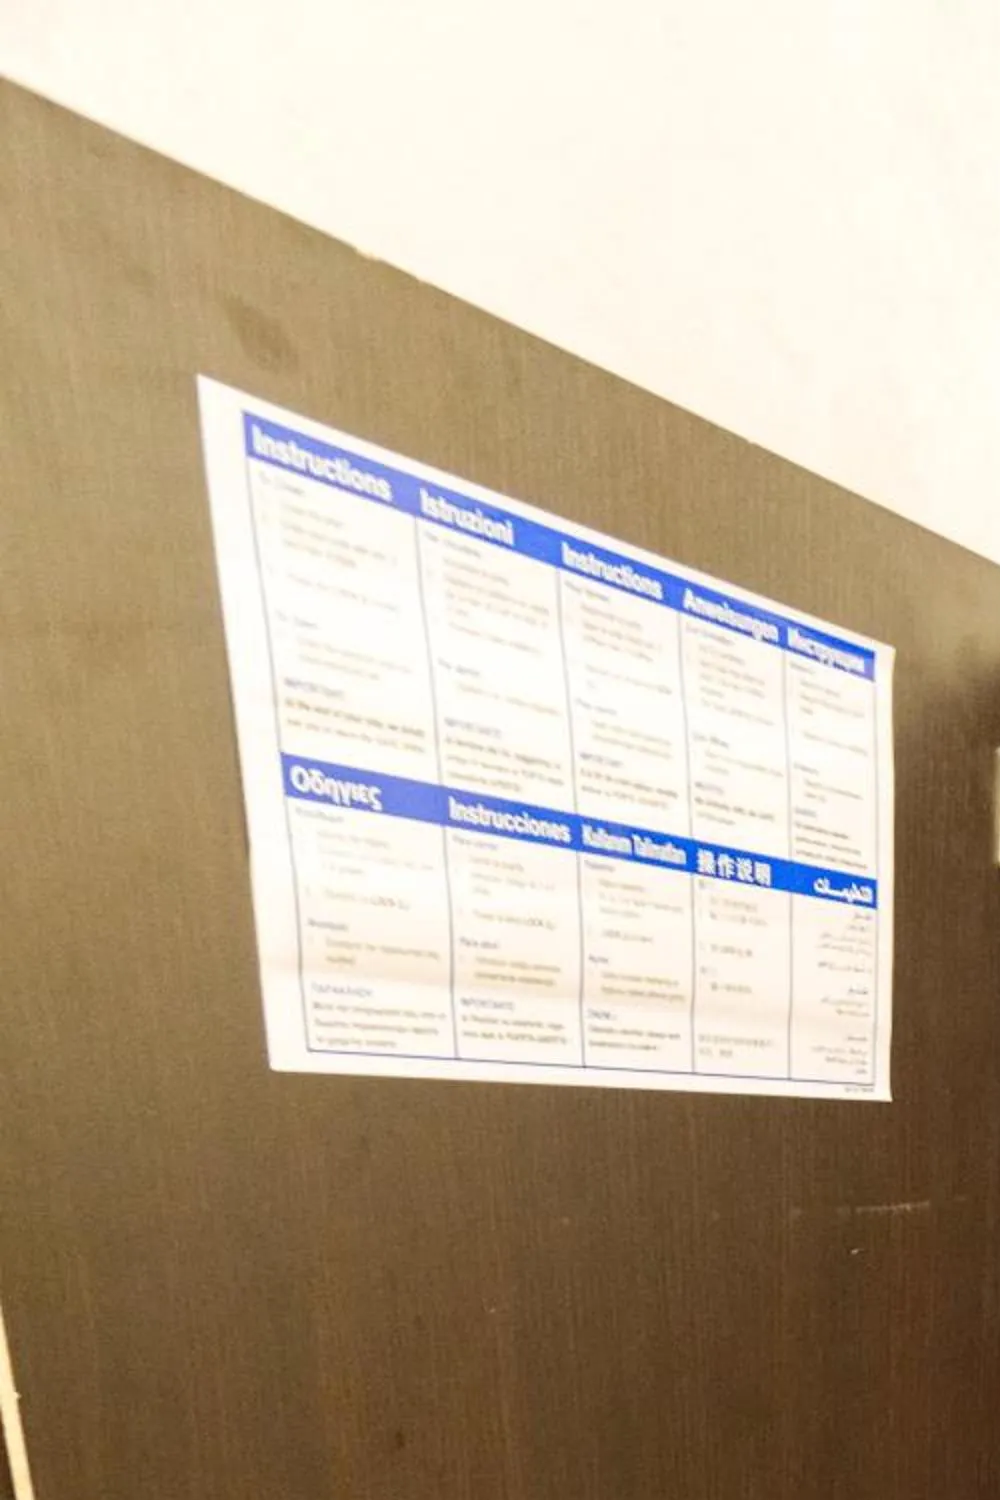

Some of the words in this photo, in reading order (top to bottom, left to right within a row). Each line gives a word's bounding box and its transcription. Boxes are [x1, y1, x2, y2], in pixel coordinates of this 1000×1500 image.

[252, 424, 393, 501] Instructions
[420, 487, 515, 547] Istruzioni
[561, 541, 664, 600] Instructions
[449, 796, 572, 843] Instrucciones
